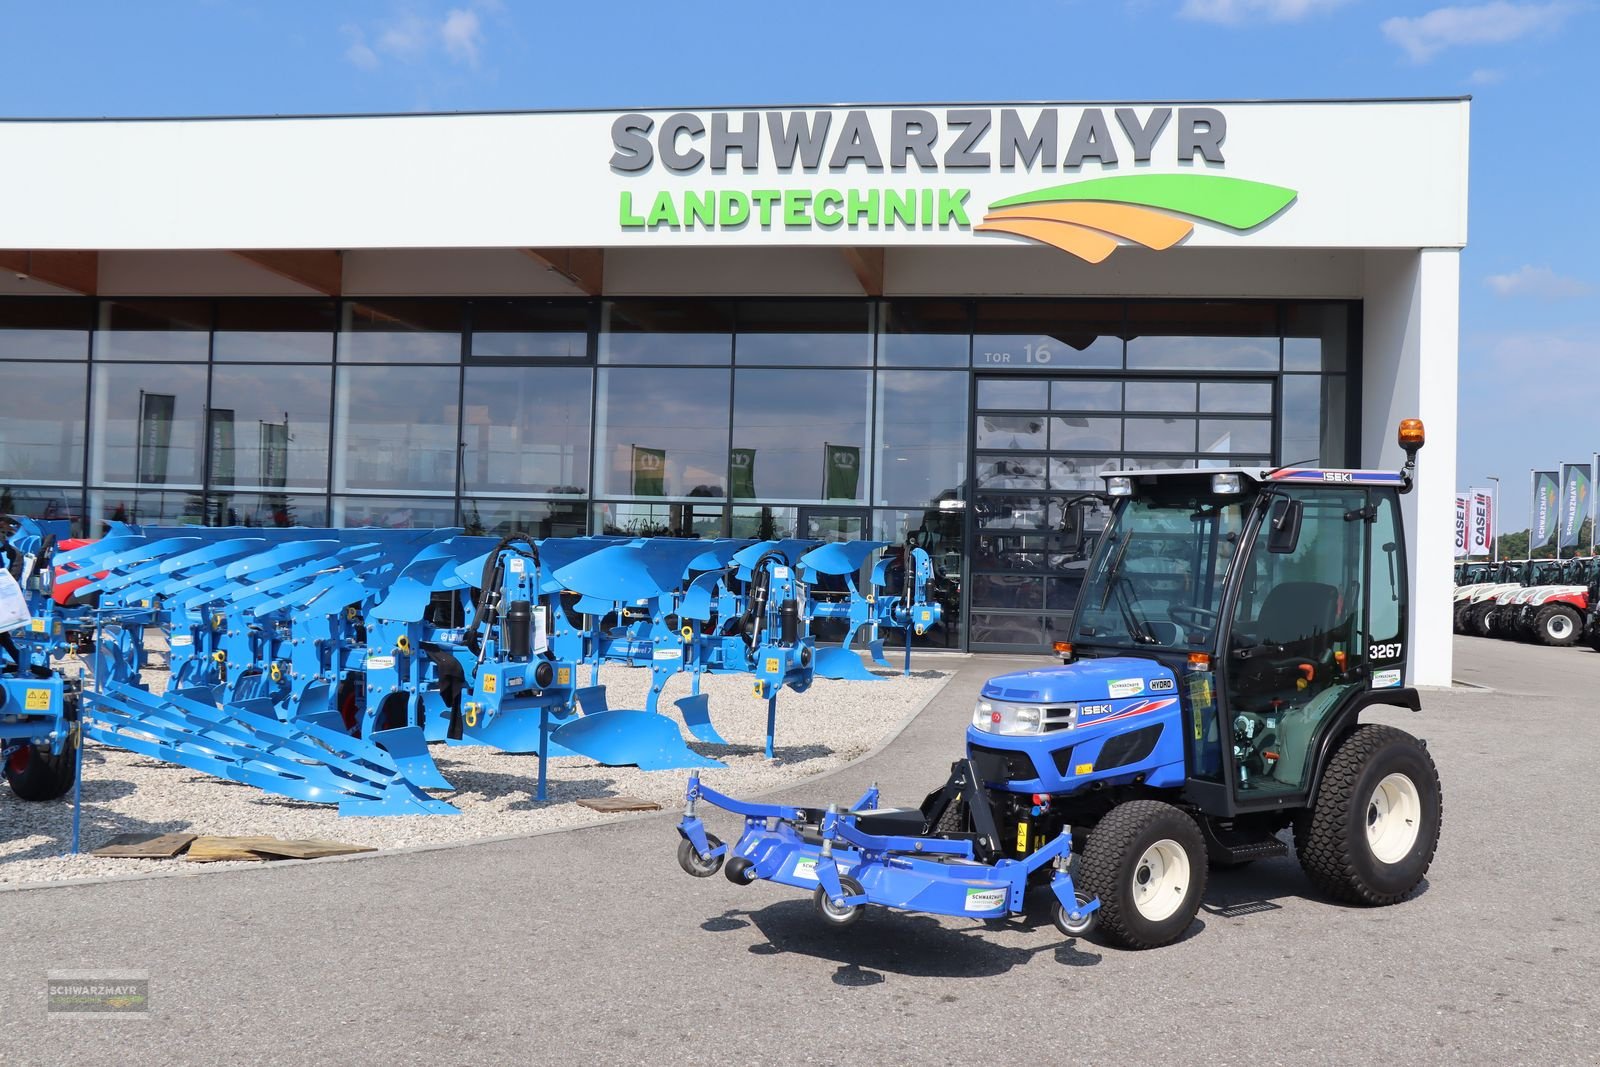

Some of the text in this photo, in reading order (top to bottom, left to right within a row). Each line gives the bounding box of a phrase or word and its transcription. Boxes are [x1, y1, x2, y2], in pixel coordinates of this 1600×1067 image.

[609, 107, 1227, 171] SCHWARZMAYR
[620, 189, 971, 227] LANDTECHNIK
[984, 344, 1052, 364] TOR 16
[1323, 472, 1353, 482] ISEKI
[1475, 507, 1485, 546] CASE
[1538, 487, 1547, 539] SCHWARZMAYR
[1567, 481, 1577, 536] SCHWARZMAYR
[1455, 511, 1464, 548] CASE
[1370, 643, 1401, 659] 3267
[1152, 681, 1171, 689] HYDRO
[1081, 704, 1112, 716] ISEKI
